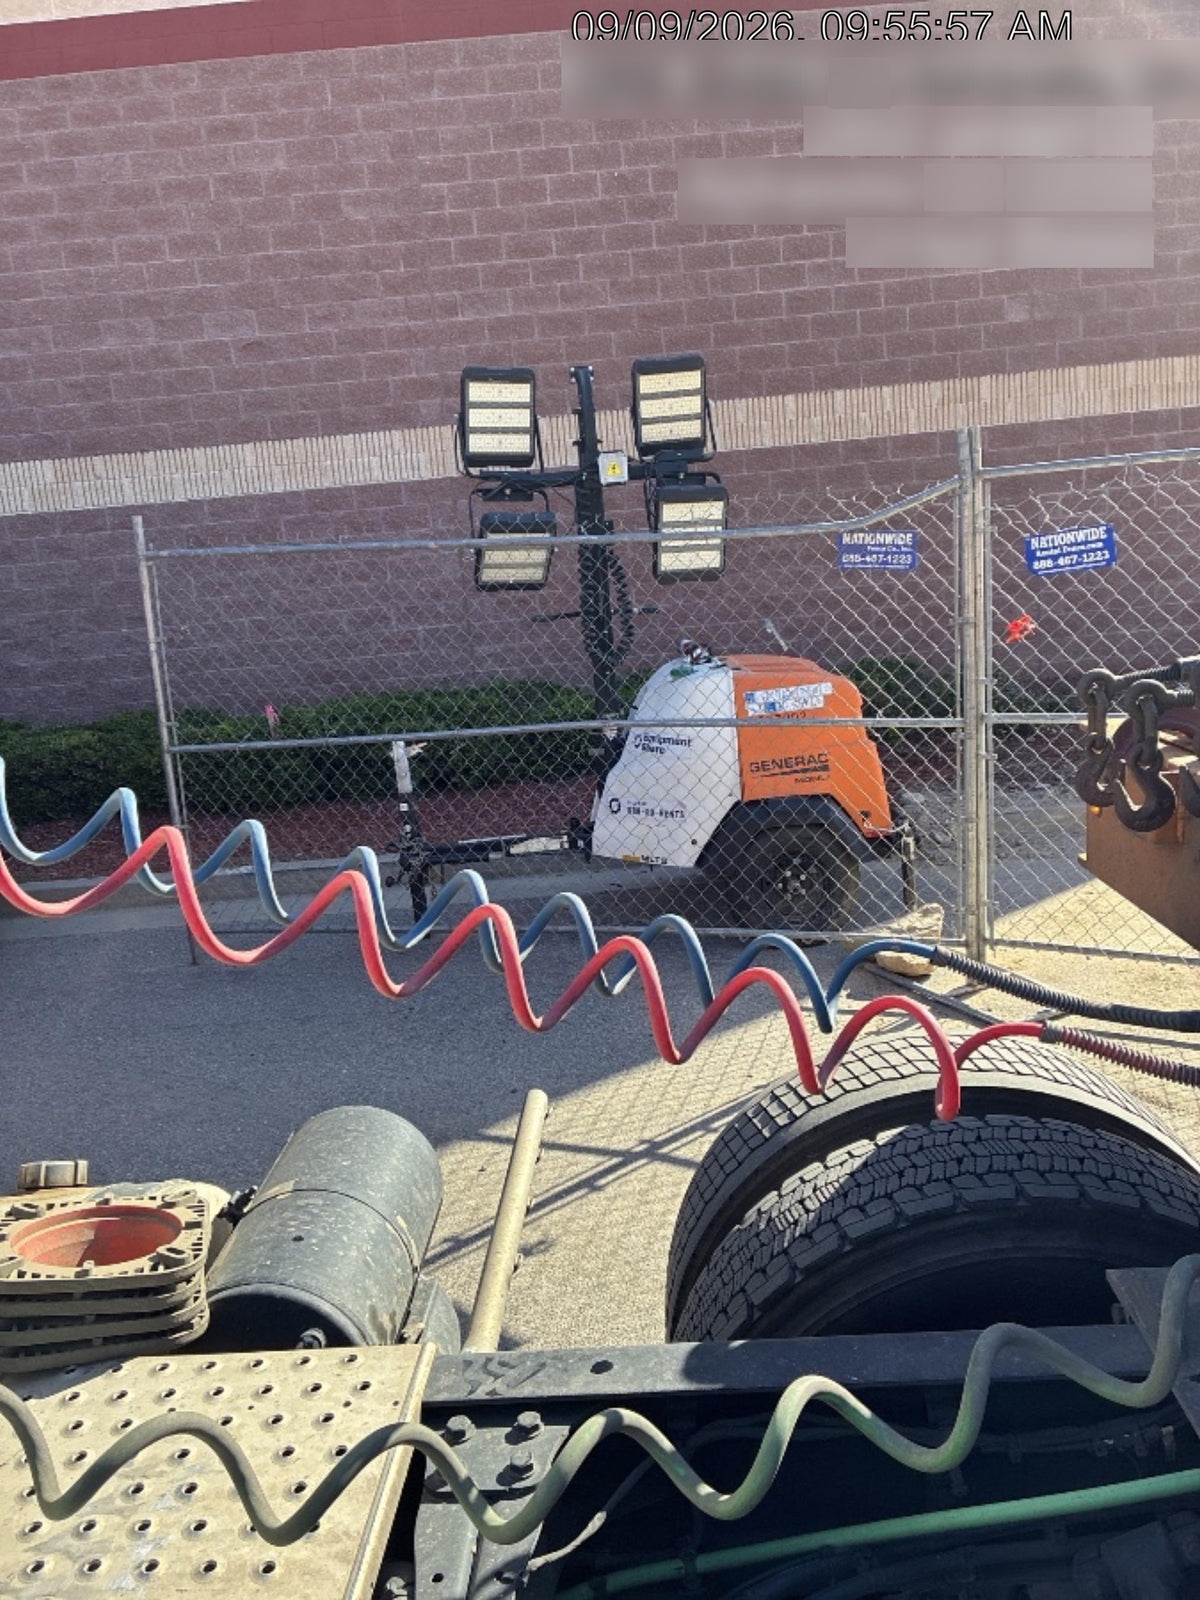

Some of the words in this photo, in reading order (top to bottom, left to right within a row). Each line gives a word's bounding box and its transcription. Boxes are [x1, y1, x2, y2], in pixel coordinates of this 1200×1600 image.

[842, 532, 913, 545] NATIONWIDE
[1030, 526, 1107, 550] NATIONWIDE
[1032, 550, 1110, 569] 888-467-1223
[750, 753, 829, 773] GENERAC
